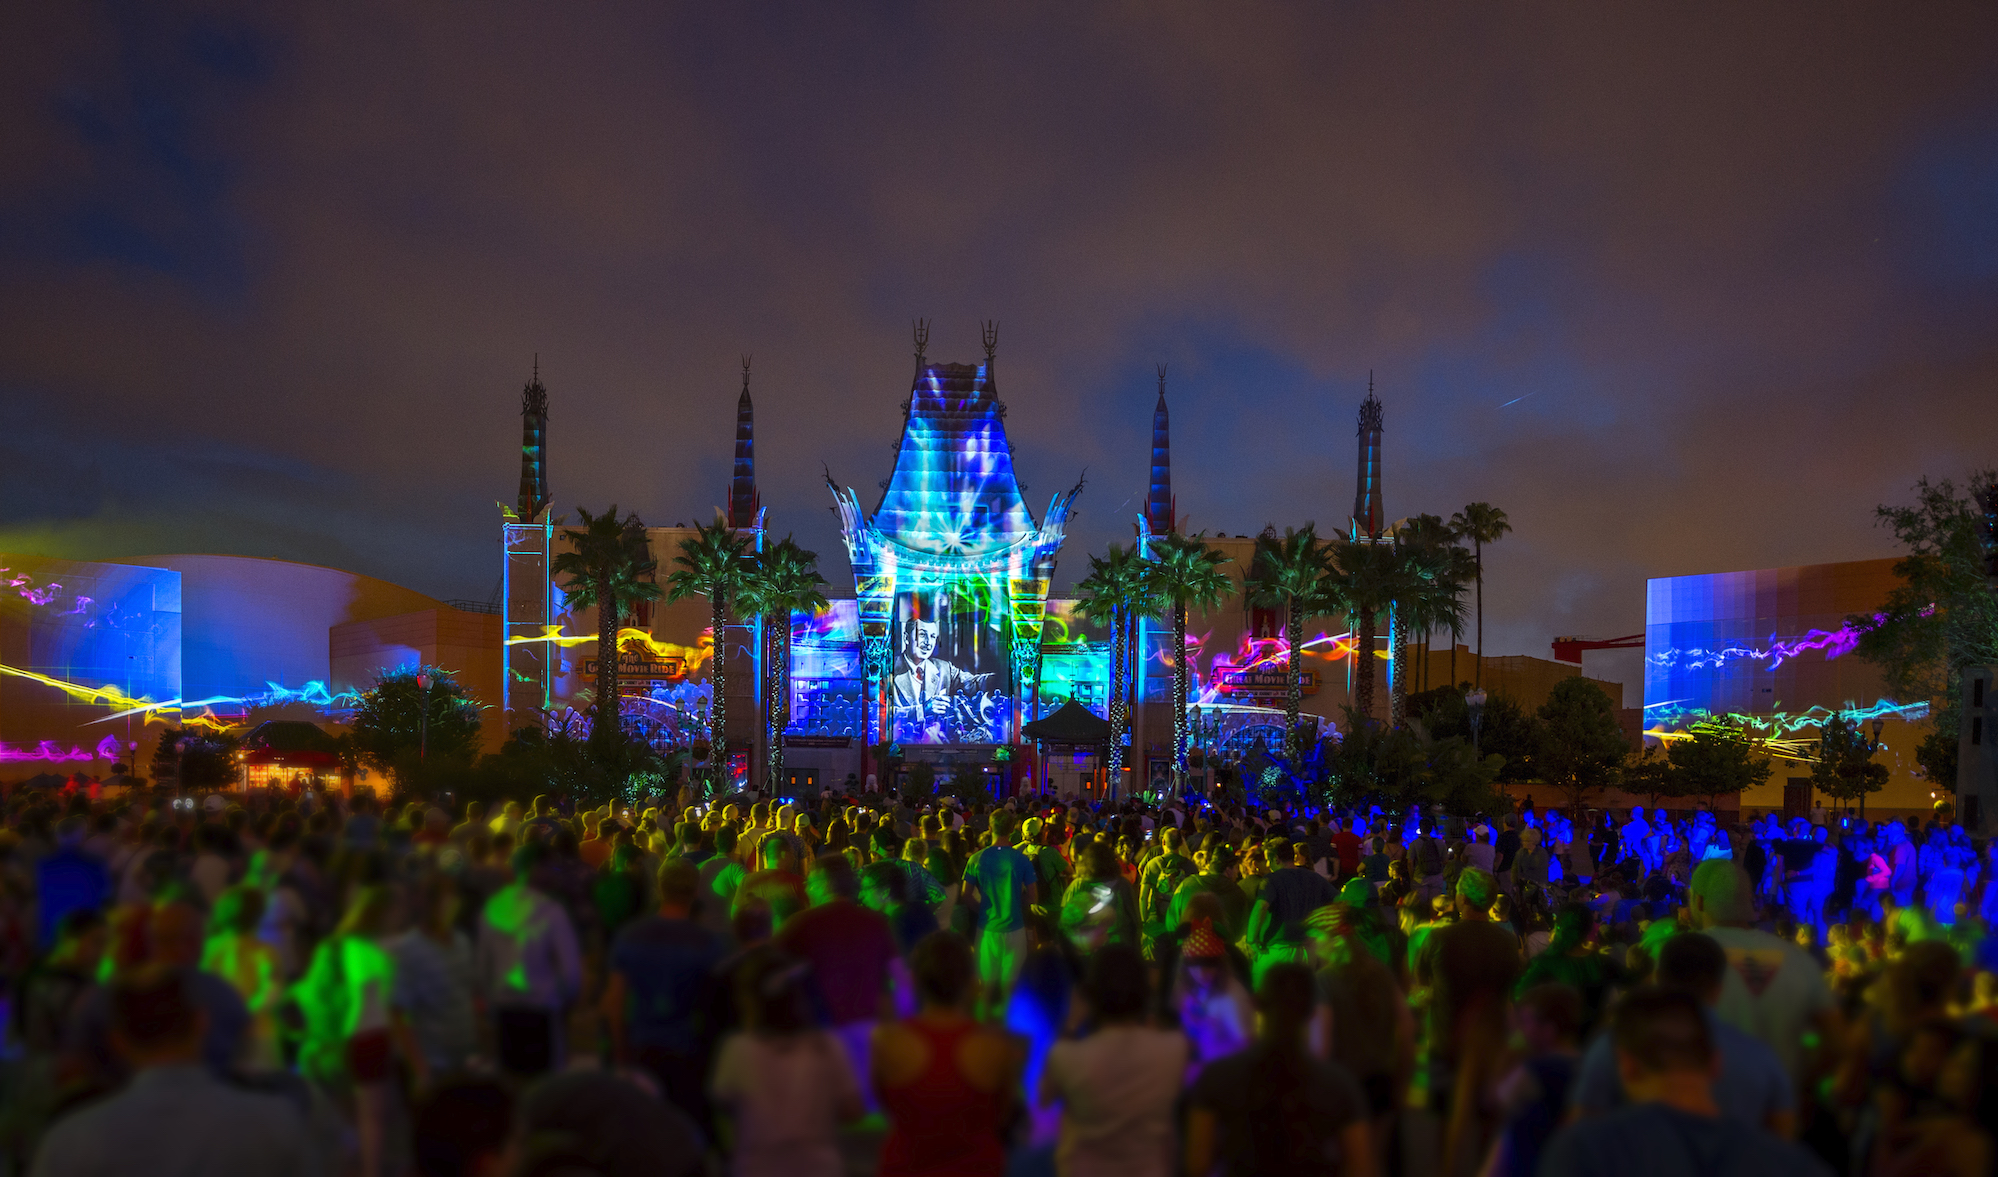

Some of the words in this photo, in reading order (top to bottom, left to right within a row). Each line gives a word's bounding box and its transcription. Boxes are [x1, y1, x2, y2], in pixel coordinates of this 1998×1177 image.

[618, 663, 649, 673] MOVIE
[650, 663, 675, 674] RIDE
[1255, 674, 1285, 684] MOVIE
